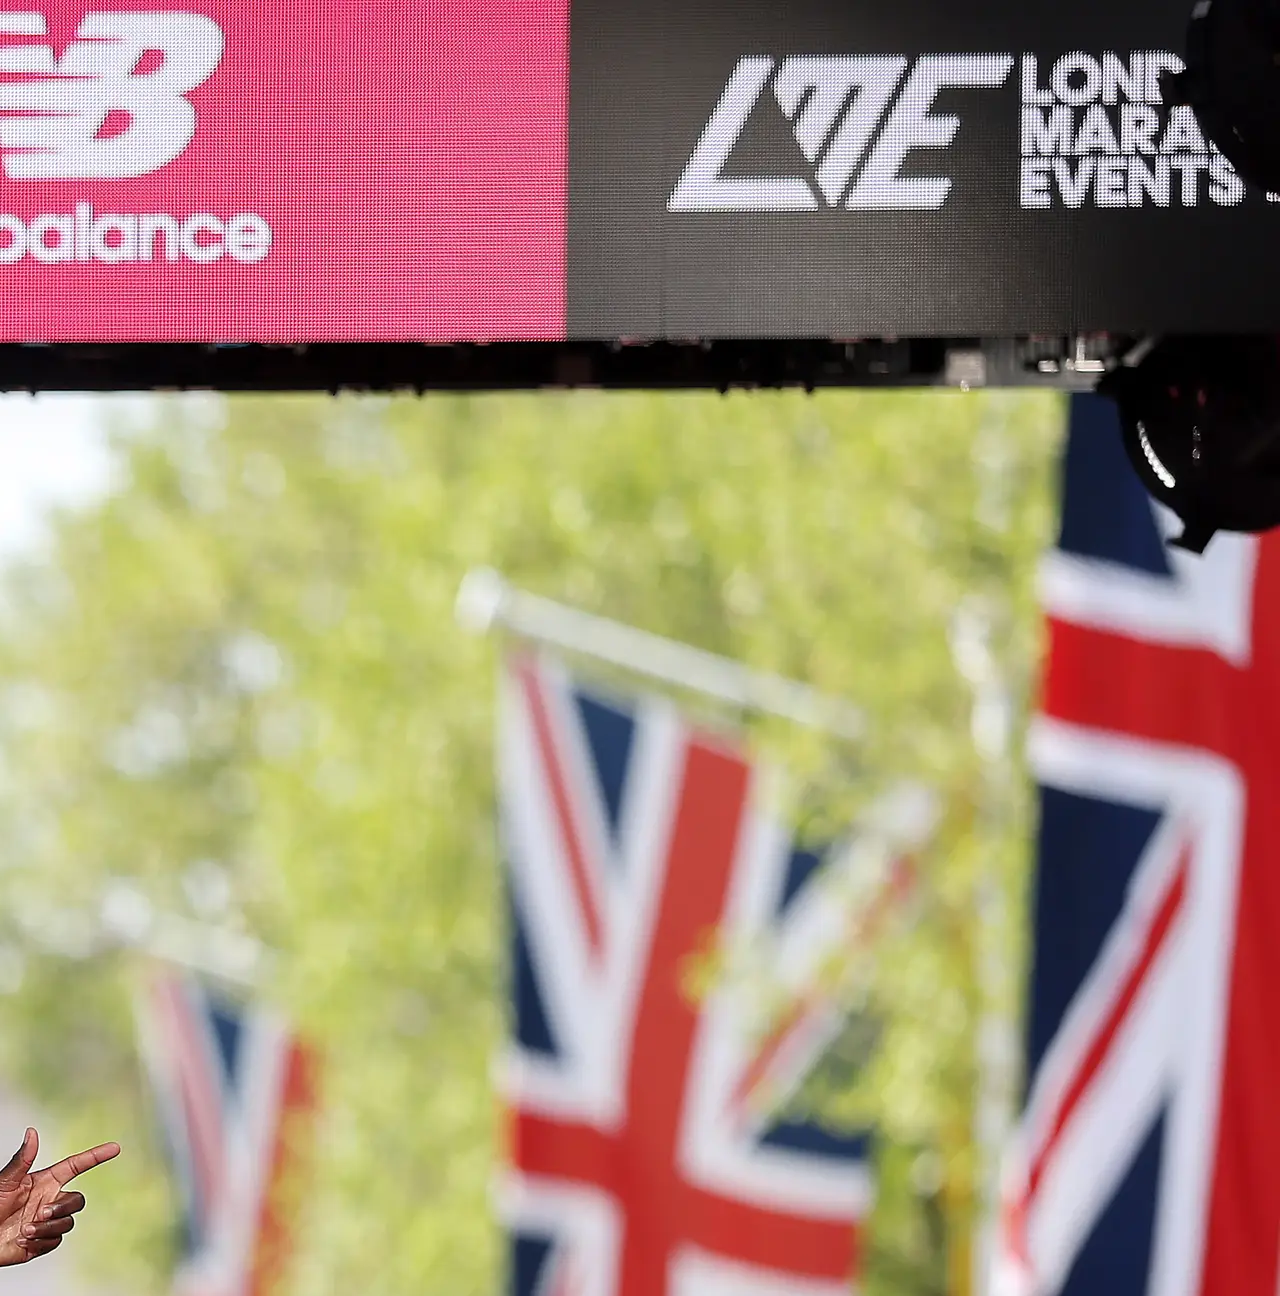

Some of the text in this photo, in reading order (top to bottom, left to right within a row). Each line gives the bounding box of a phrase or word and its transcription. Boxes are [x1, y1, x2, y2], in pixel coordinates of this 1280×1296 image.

[1019, 49, 1187, 105] LOND
[1019, 101, 1220, 156] MARA
[1019, 152, 1246, 209] EVENTS
